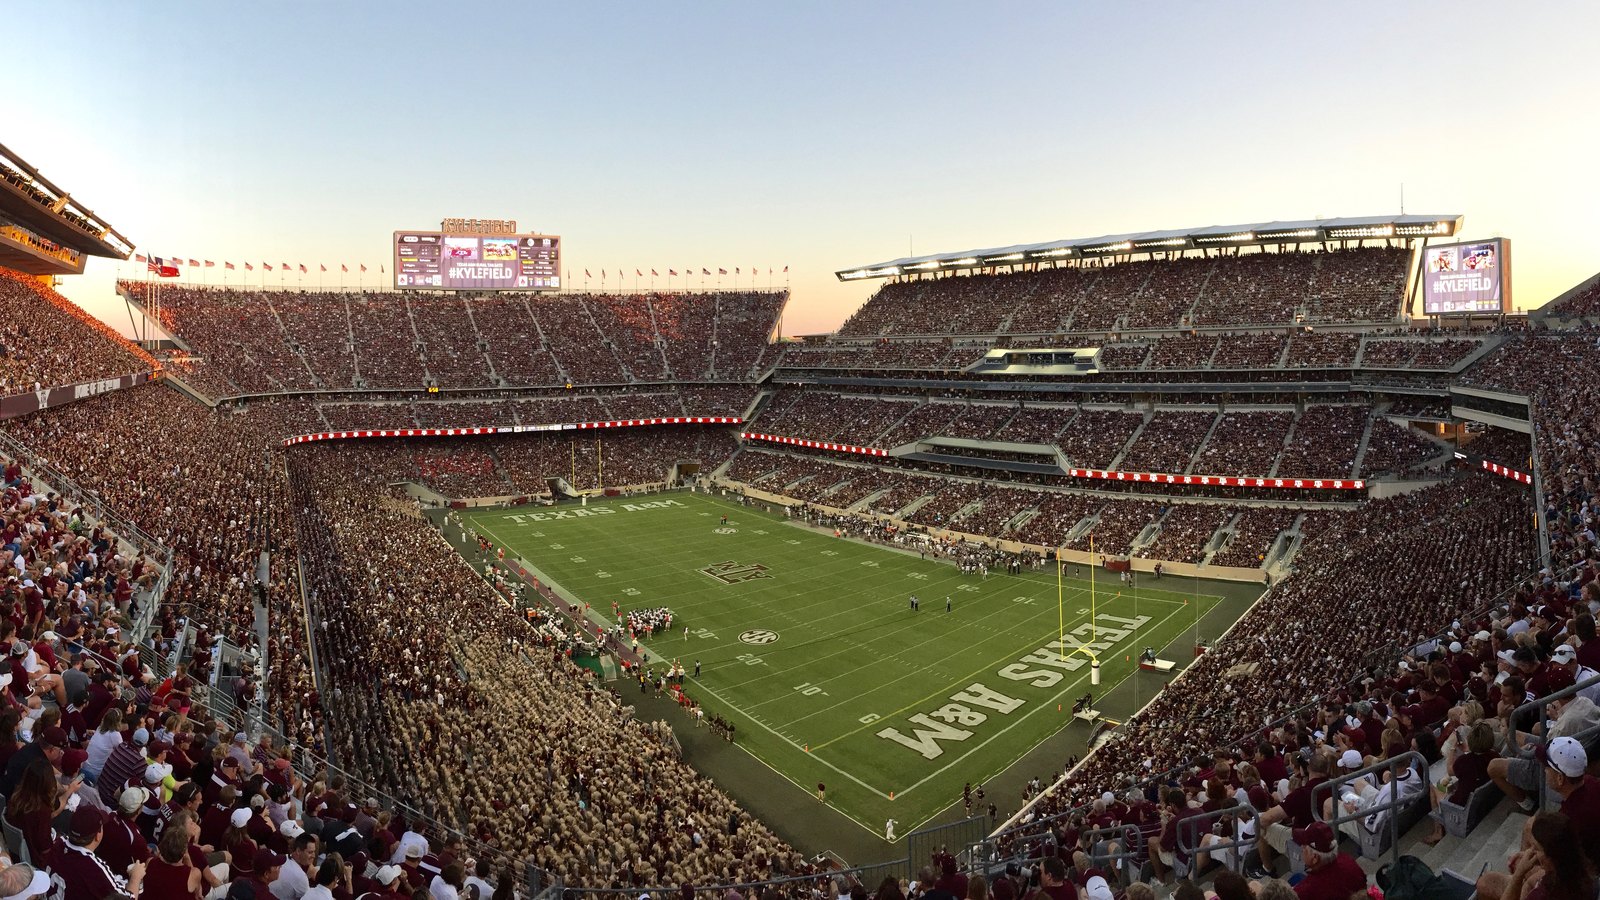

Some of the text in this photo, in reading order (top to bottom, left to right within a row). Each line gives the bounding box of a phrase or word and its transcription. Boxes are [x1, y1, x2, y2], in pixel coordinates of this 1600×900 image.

[444, 218, 516, 234] KYLE FIELD
[448, 267, 513, 280] #KYLEFIELD
[1433, 277, 1492, 293] #KYLEFIELD
[502, 499, 686, 524] TEXAS A&M
[736, 653, 764, 666] 20
[793, 682, 822, 696] 10
[876, 613, 1153, 760] TEXAS A&M
